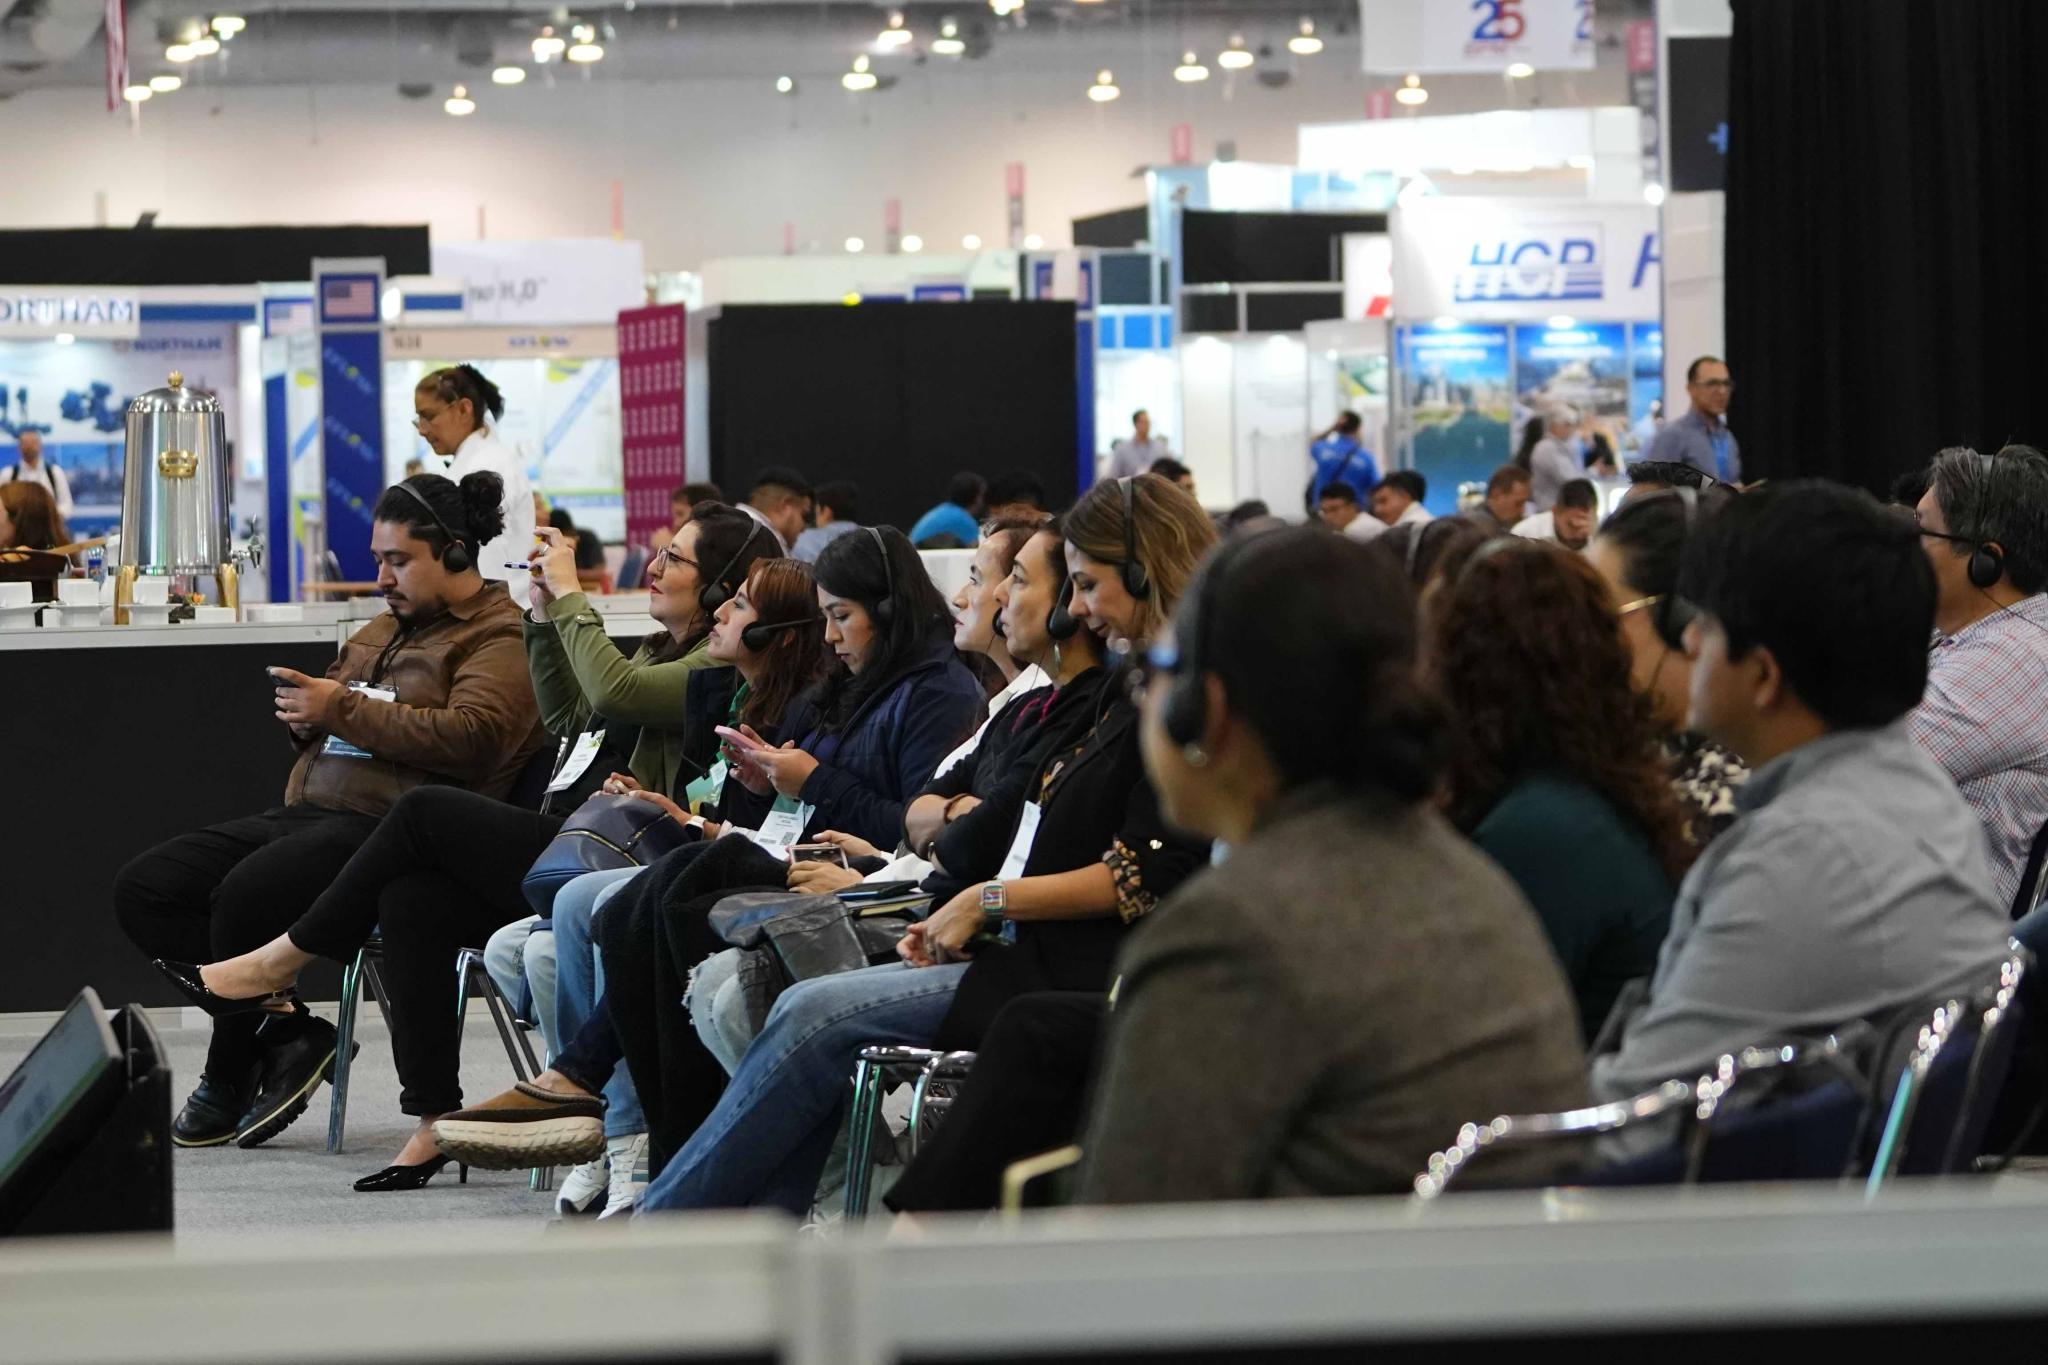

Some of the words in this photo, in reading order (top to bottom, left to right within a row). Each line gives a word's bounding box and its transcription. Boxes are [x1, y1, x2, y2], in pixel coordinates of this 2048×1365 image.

[1471, 0, 1524, 41] 25
[1457, 239, 1596, 299] HCP
[134, 337, 221, 350] NORTHAM
